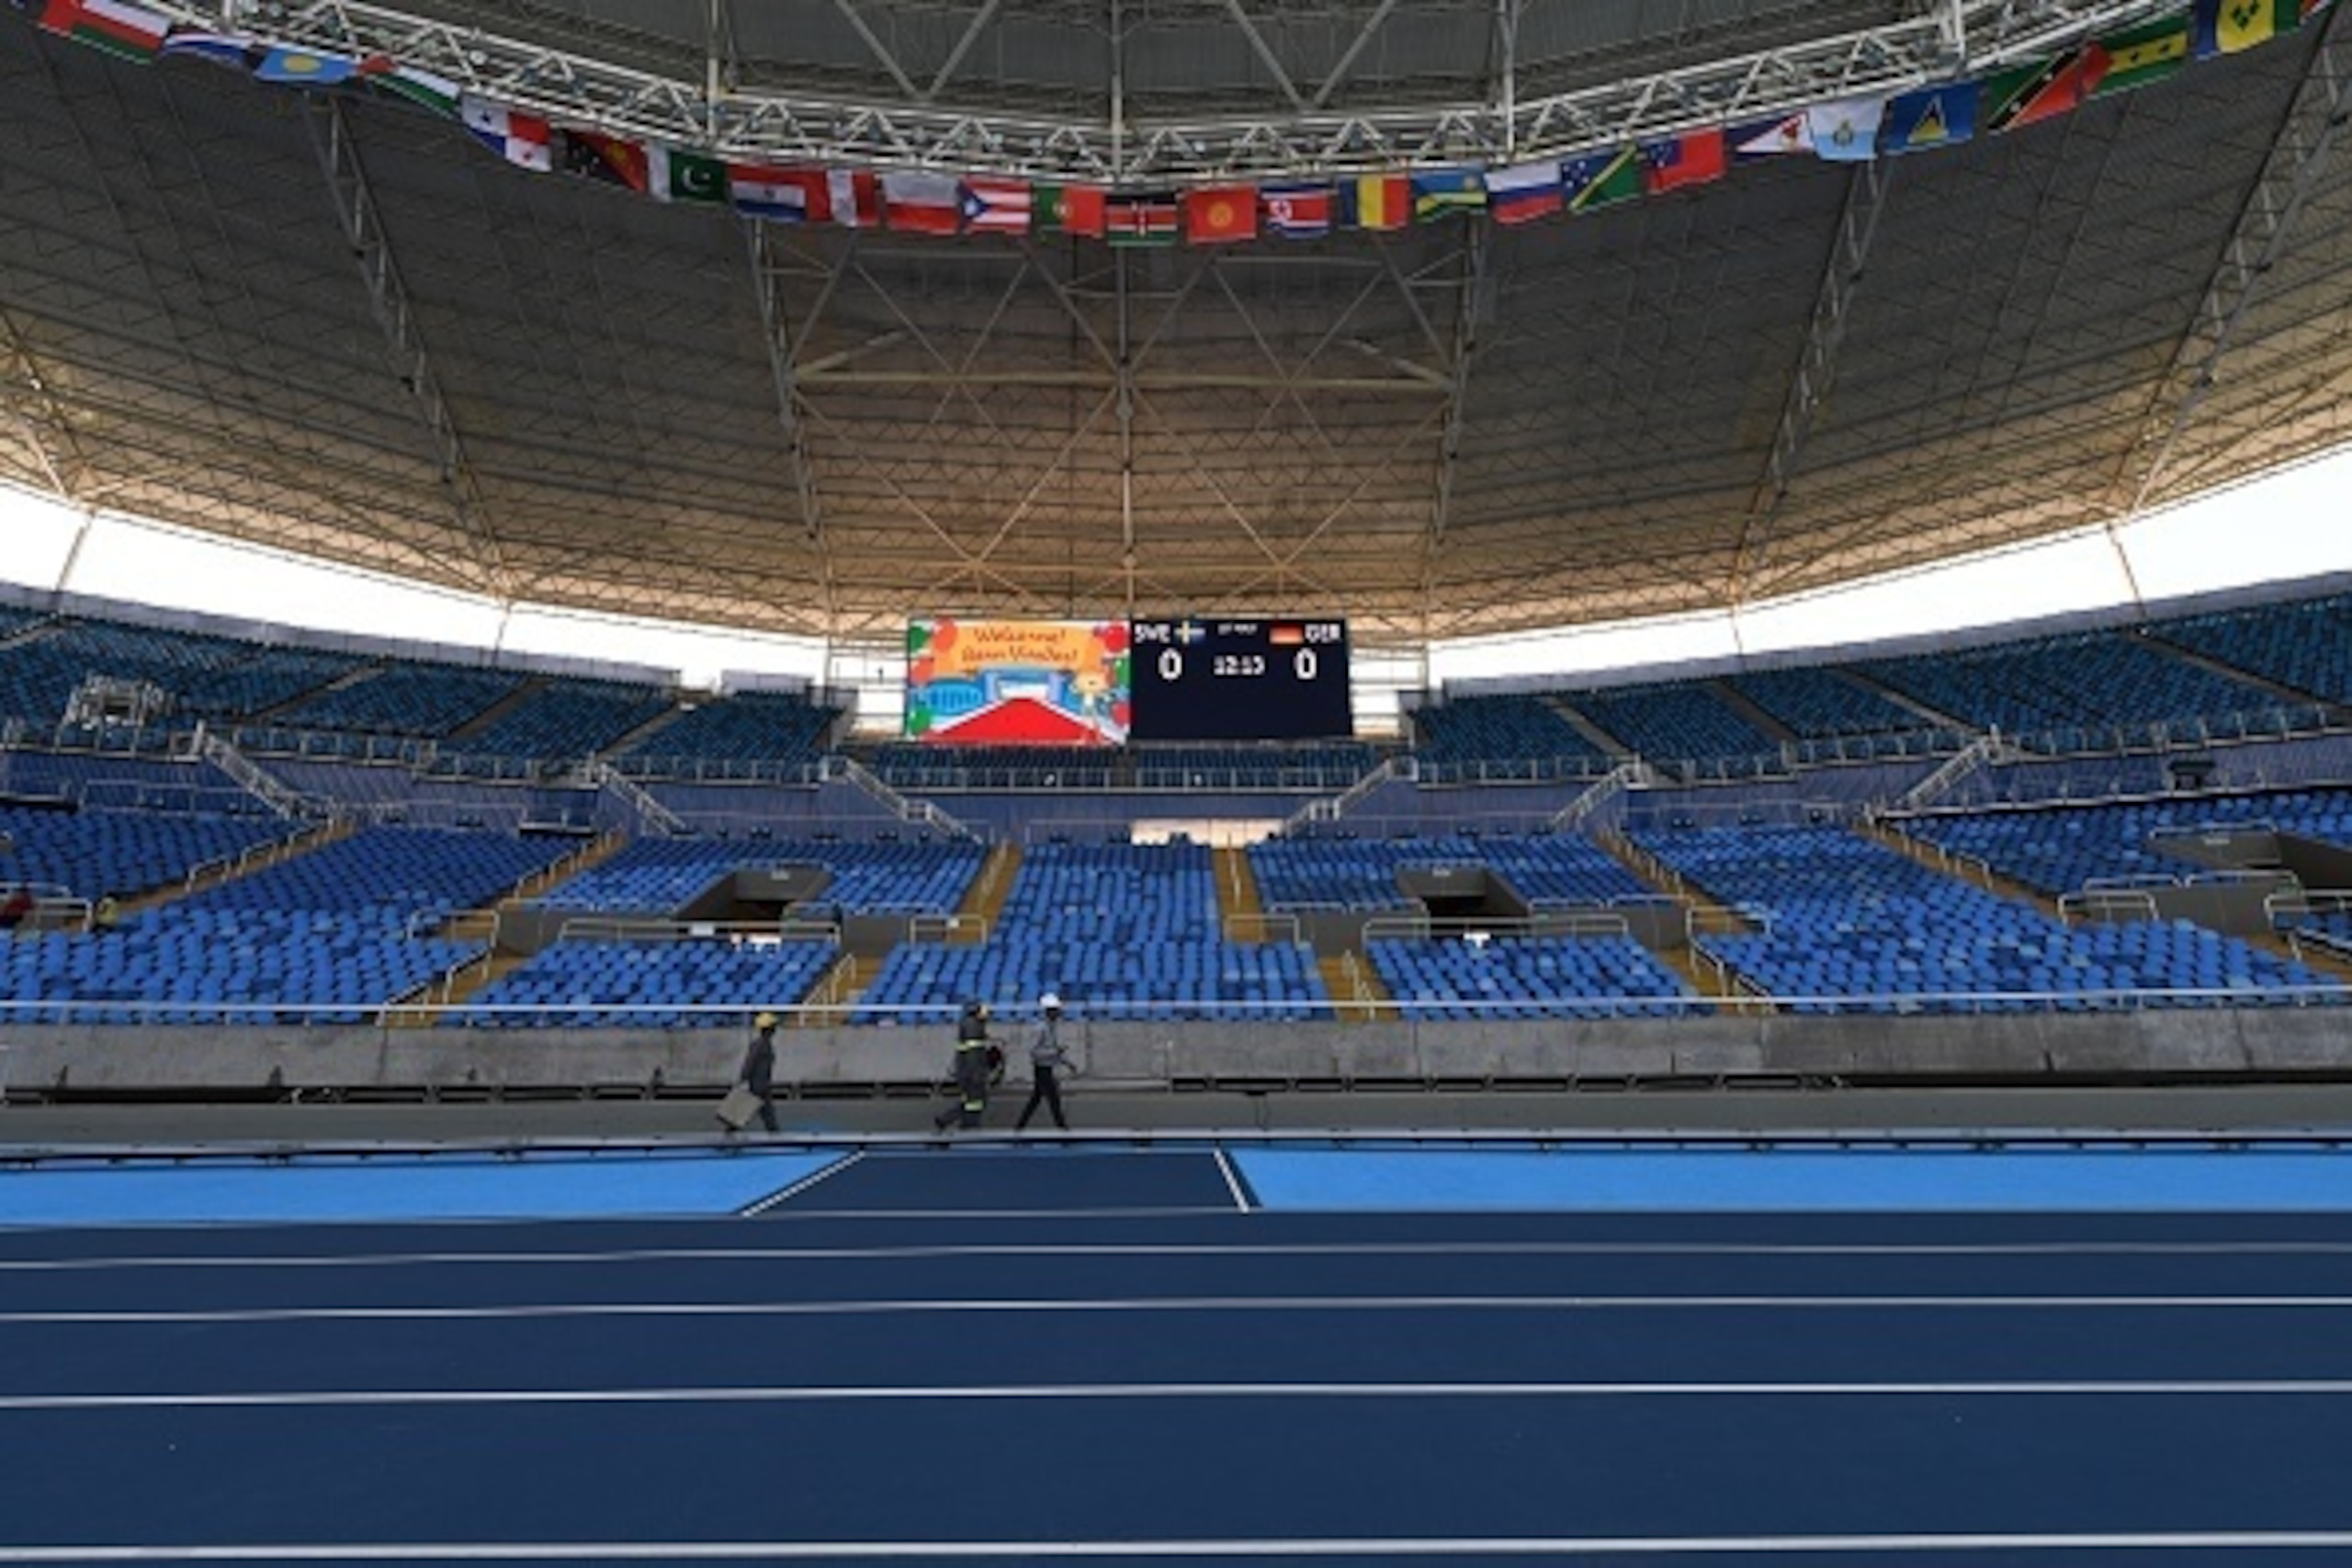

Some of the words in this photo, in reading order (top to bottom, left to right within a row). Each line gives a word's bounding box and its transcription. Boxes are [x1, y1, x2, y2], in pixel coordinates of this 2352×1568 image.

[1134, 624, 1170, 644] SWE
[1305, 624, 1340, 643] GER
[1158, 647, 1182, 680] 0
[1295, 647, 1317, 680] 0
